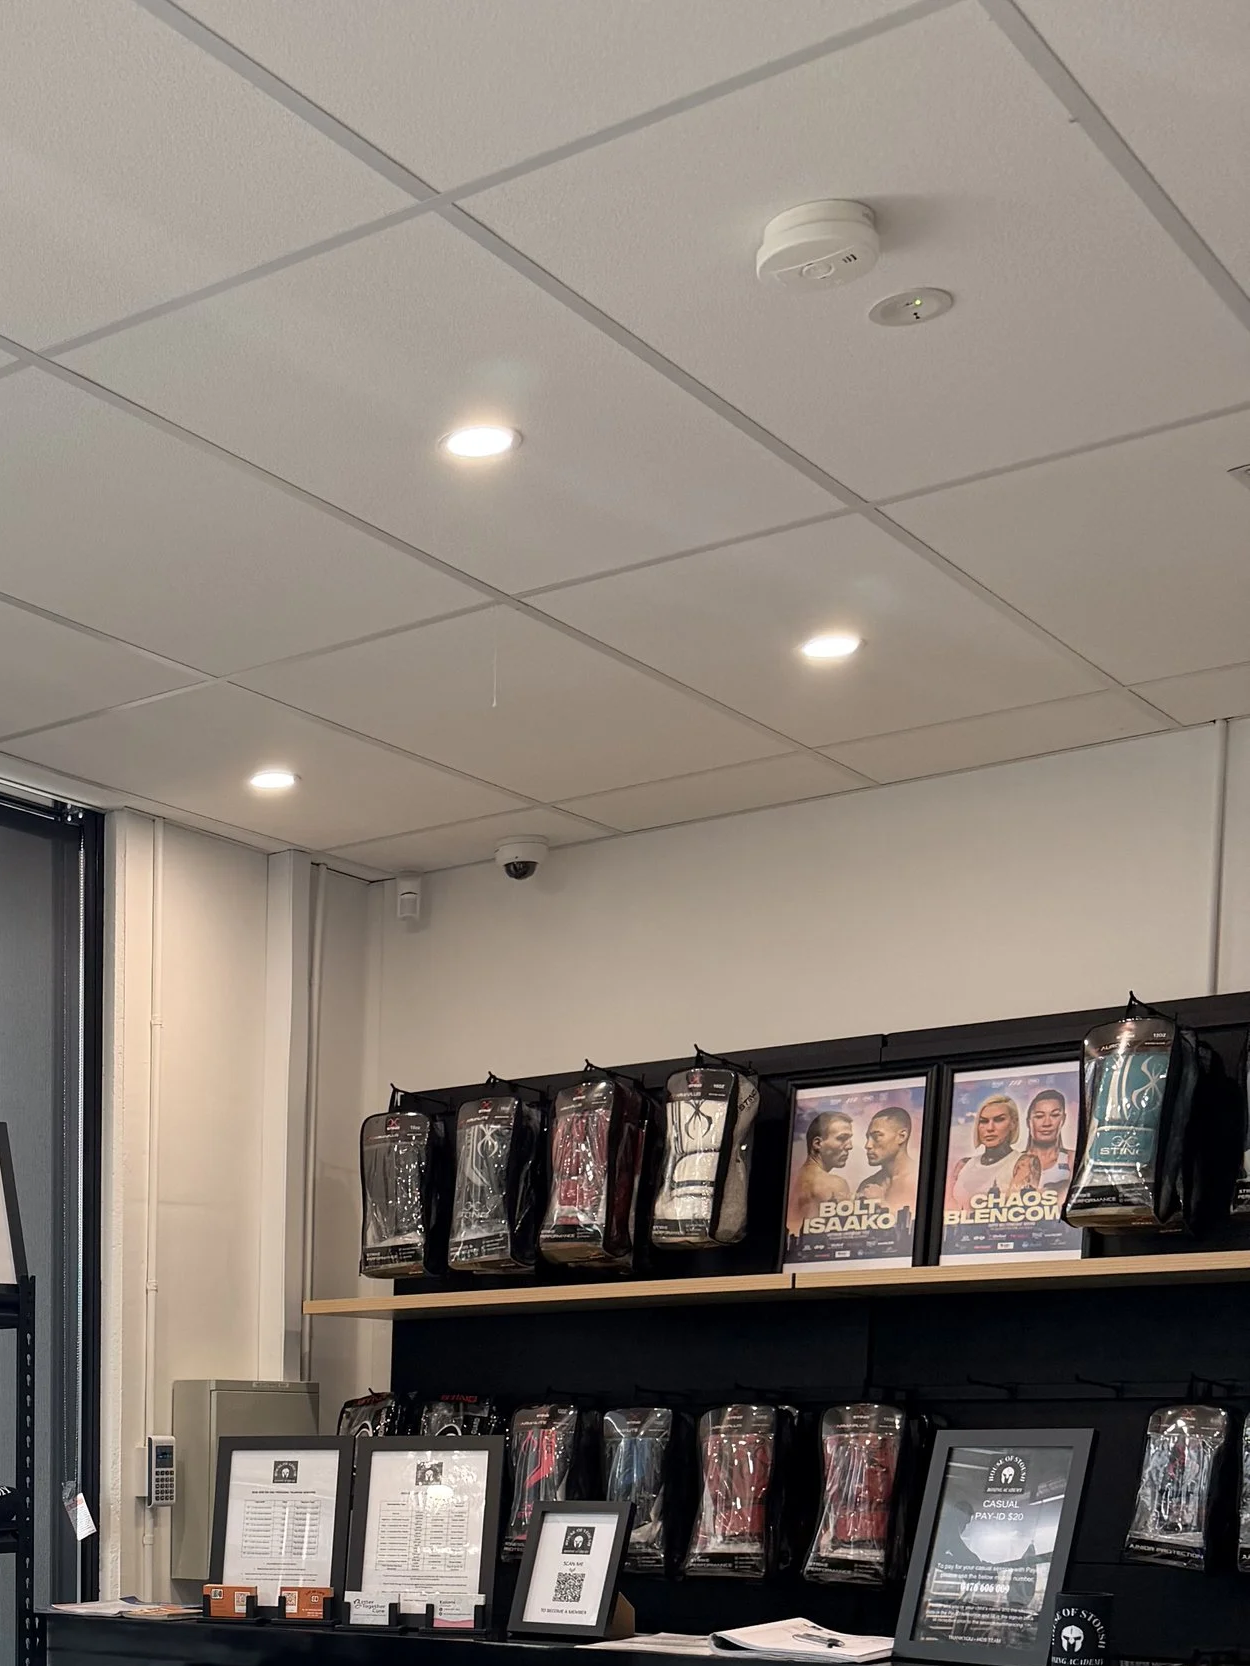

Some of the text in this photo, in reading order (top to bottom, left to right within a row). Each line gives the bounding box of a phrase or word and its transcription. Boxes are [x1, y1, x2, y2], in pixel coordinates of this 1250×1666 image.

[1101, 1041, 1131, 1051] AUROA
[970, 1189, 1058, 1210] CHAOS
[818, 1198, 882, 1218] BOLT
[944, 1204, 1062, 1225] BLENCOW
[803, 1211, 897, 1235] ISAAKO
[982, 1500, 1020, 1508] CASUAL
[975, 1512, 1024, 1521] PAY-ID $20
[1062, 1607, 1079, 1617] OF
